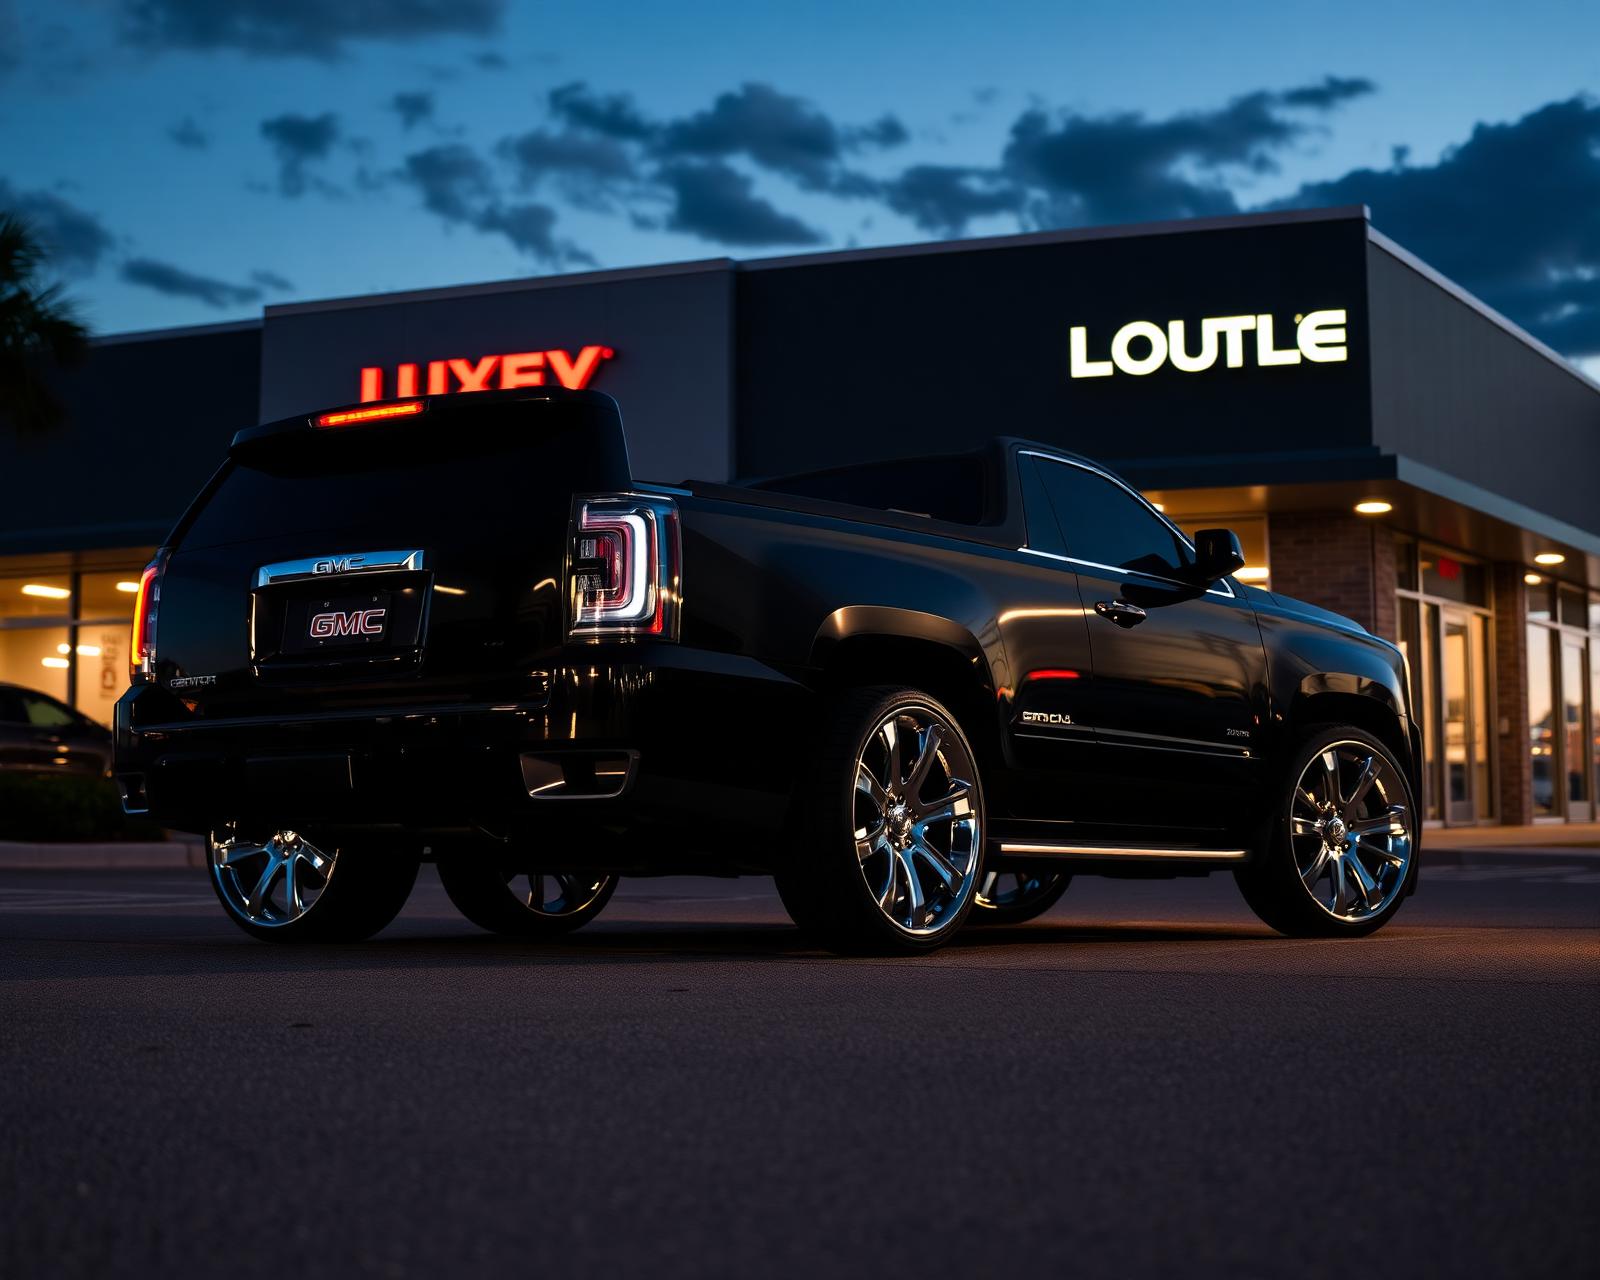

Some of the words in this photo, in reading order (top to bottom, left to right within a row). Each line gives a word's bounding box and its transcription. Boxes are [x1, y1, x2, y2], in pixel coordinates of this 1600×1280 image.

[1070, 309, 1347, 378] LOUTLE
[312, 555, 365, 575] GMC
[310, 609, 386, 638] GMC
